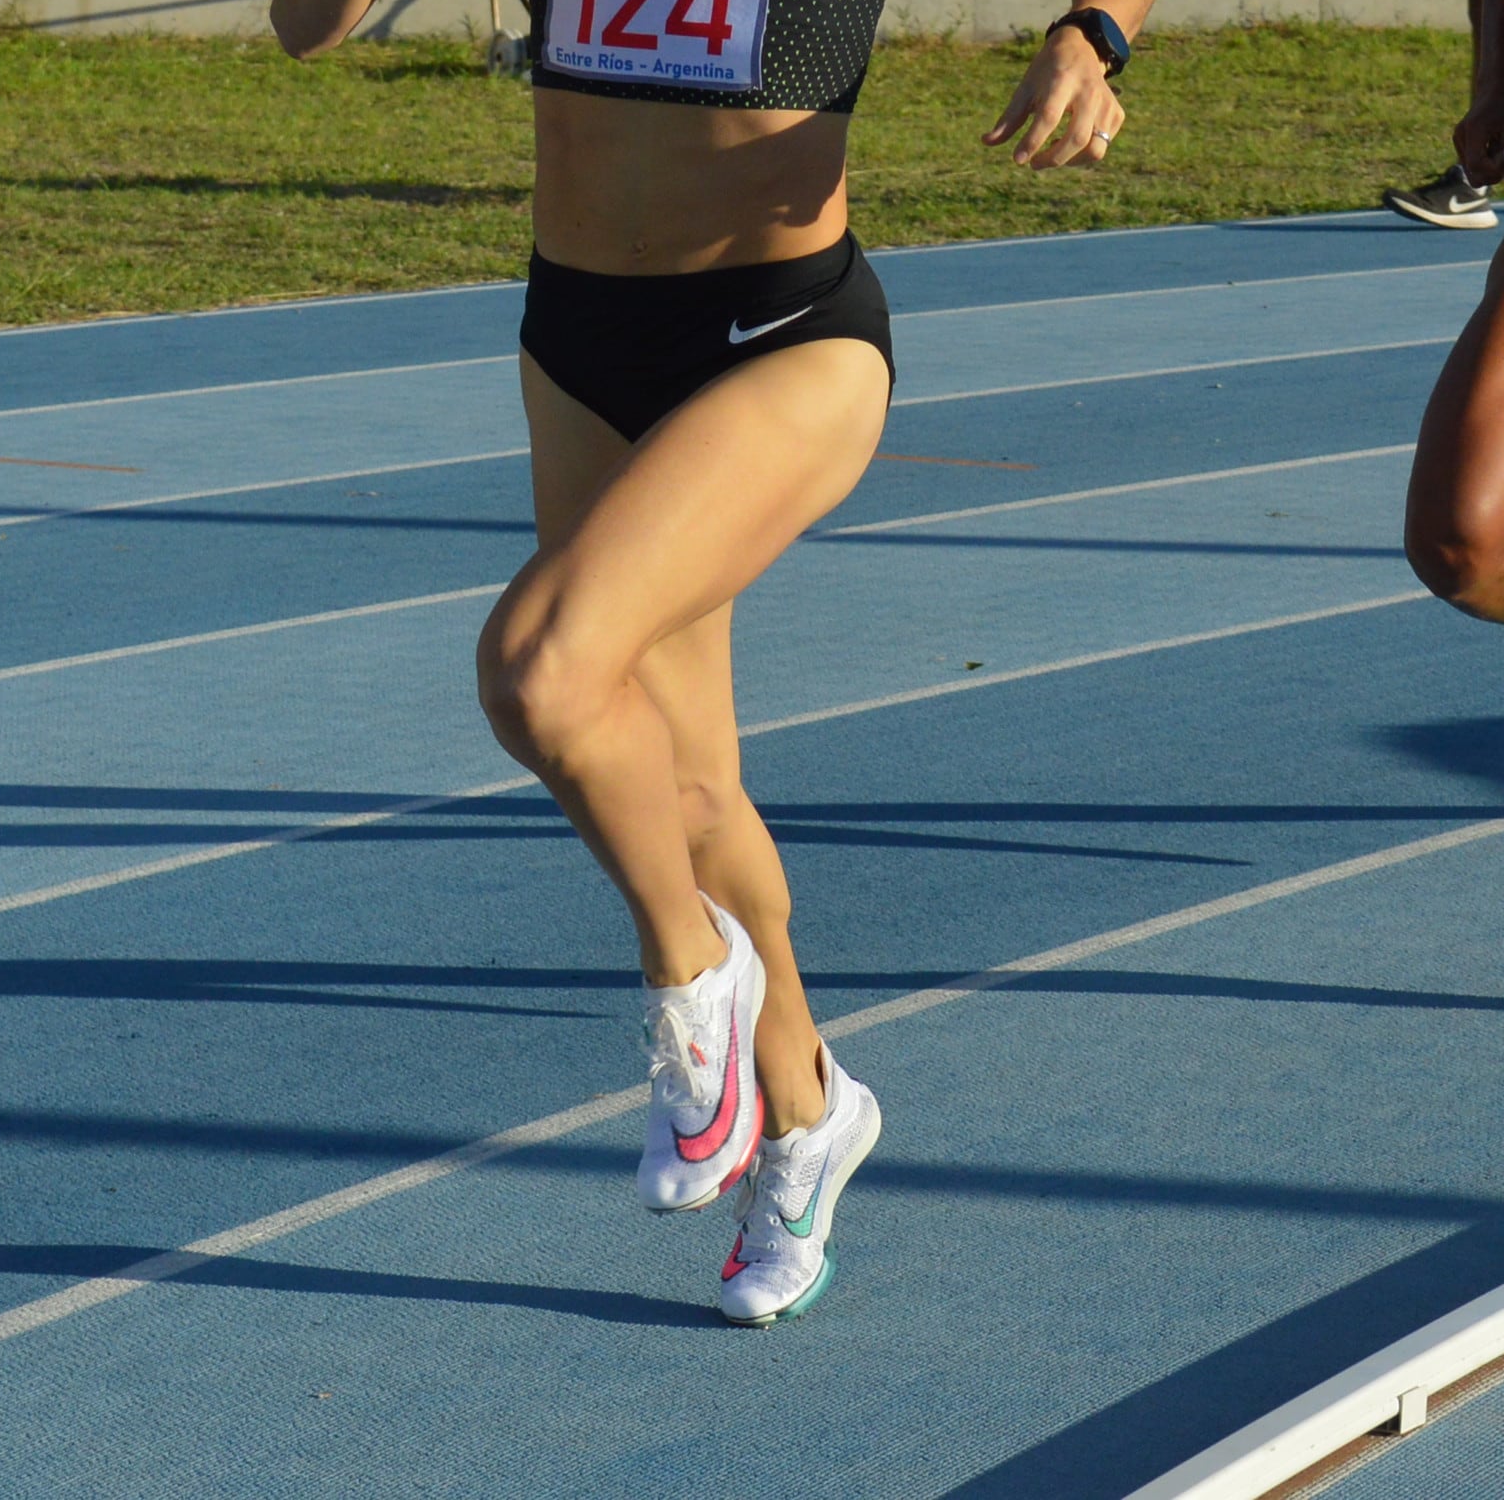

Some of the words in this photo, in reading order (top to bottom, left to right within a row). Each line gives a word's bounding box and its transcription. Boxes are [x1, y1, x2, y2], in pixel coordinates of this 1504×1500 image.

[556, 46, 593, 68] Entre
[598, 52, 634, 72] Ríos
[652, 58, 735, 80] Argentina
